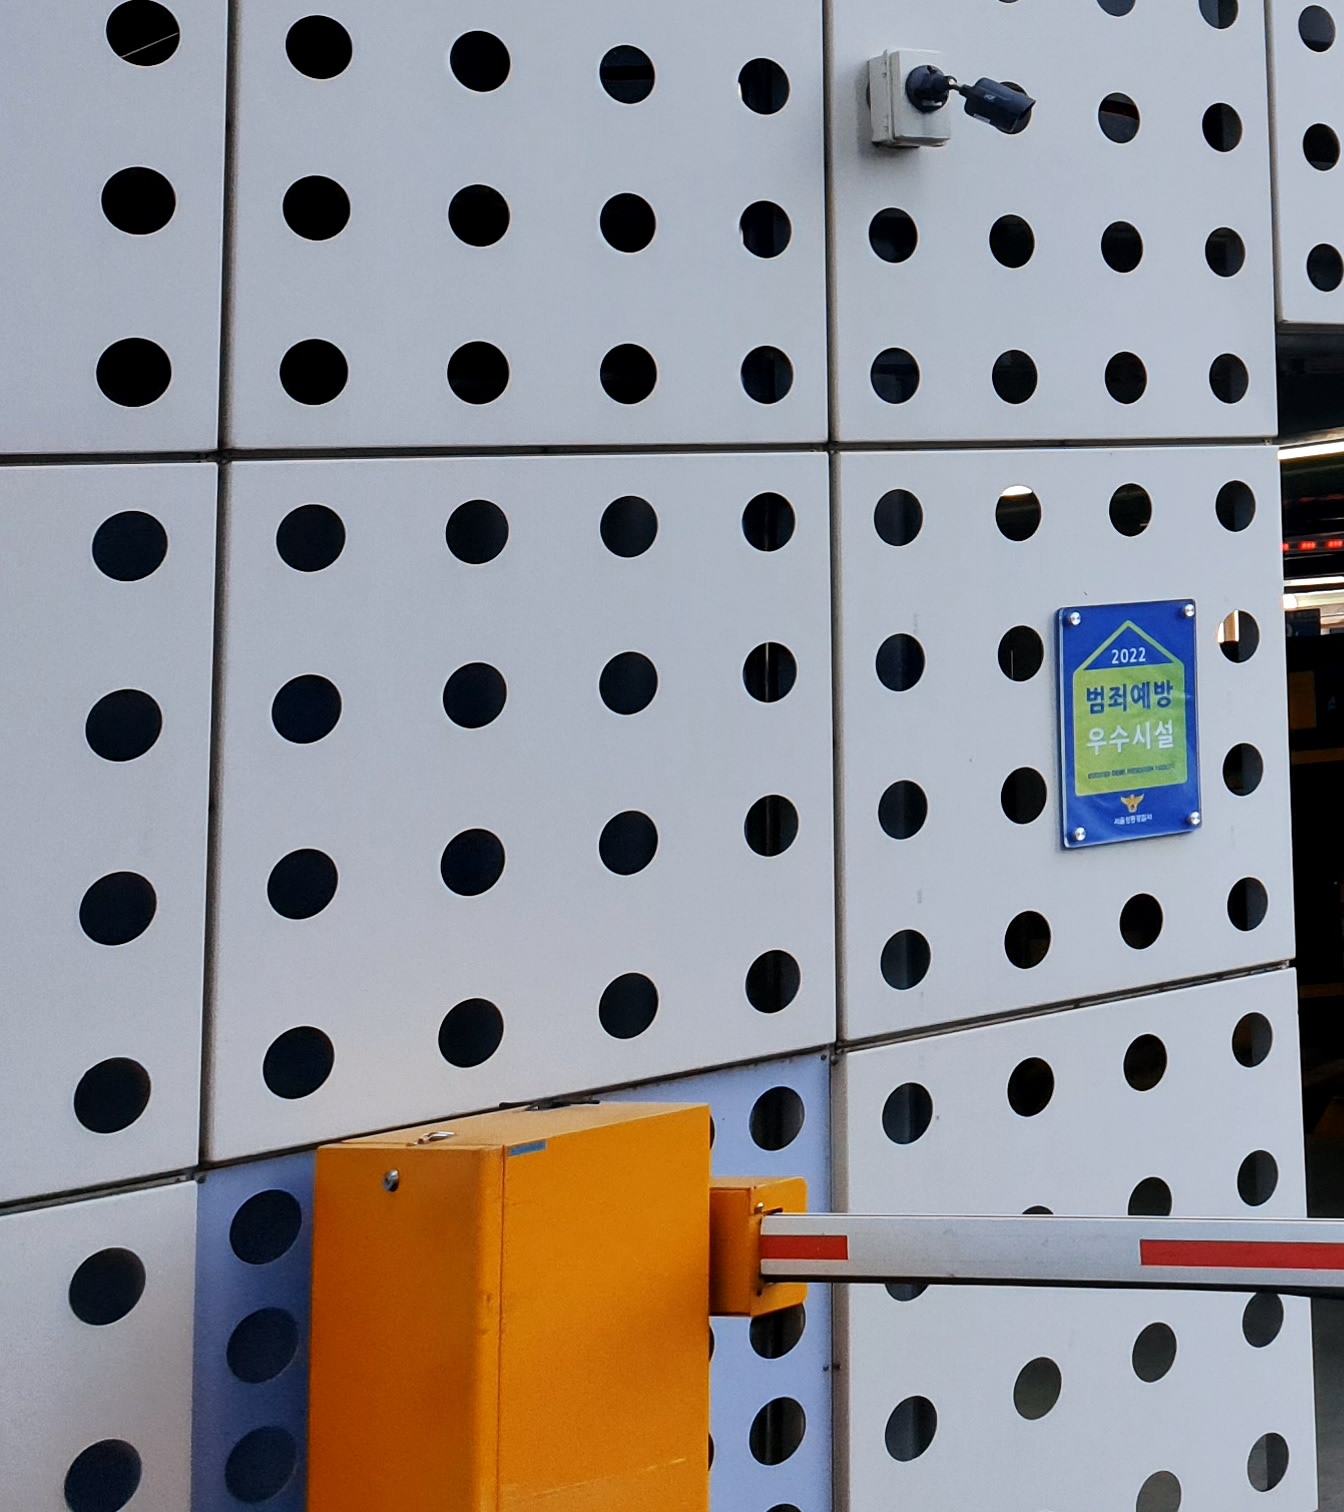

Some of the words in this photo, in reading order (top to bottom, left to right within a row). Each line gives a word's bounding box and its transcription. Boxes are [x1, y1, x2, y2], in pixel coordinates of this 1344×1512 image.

[1111, 647, 1147, 665] 2022
[1086, 679, 1174, 715] 범죄예방
[1086, 719, 1175, 756] 우수시설
